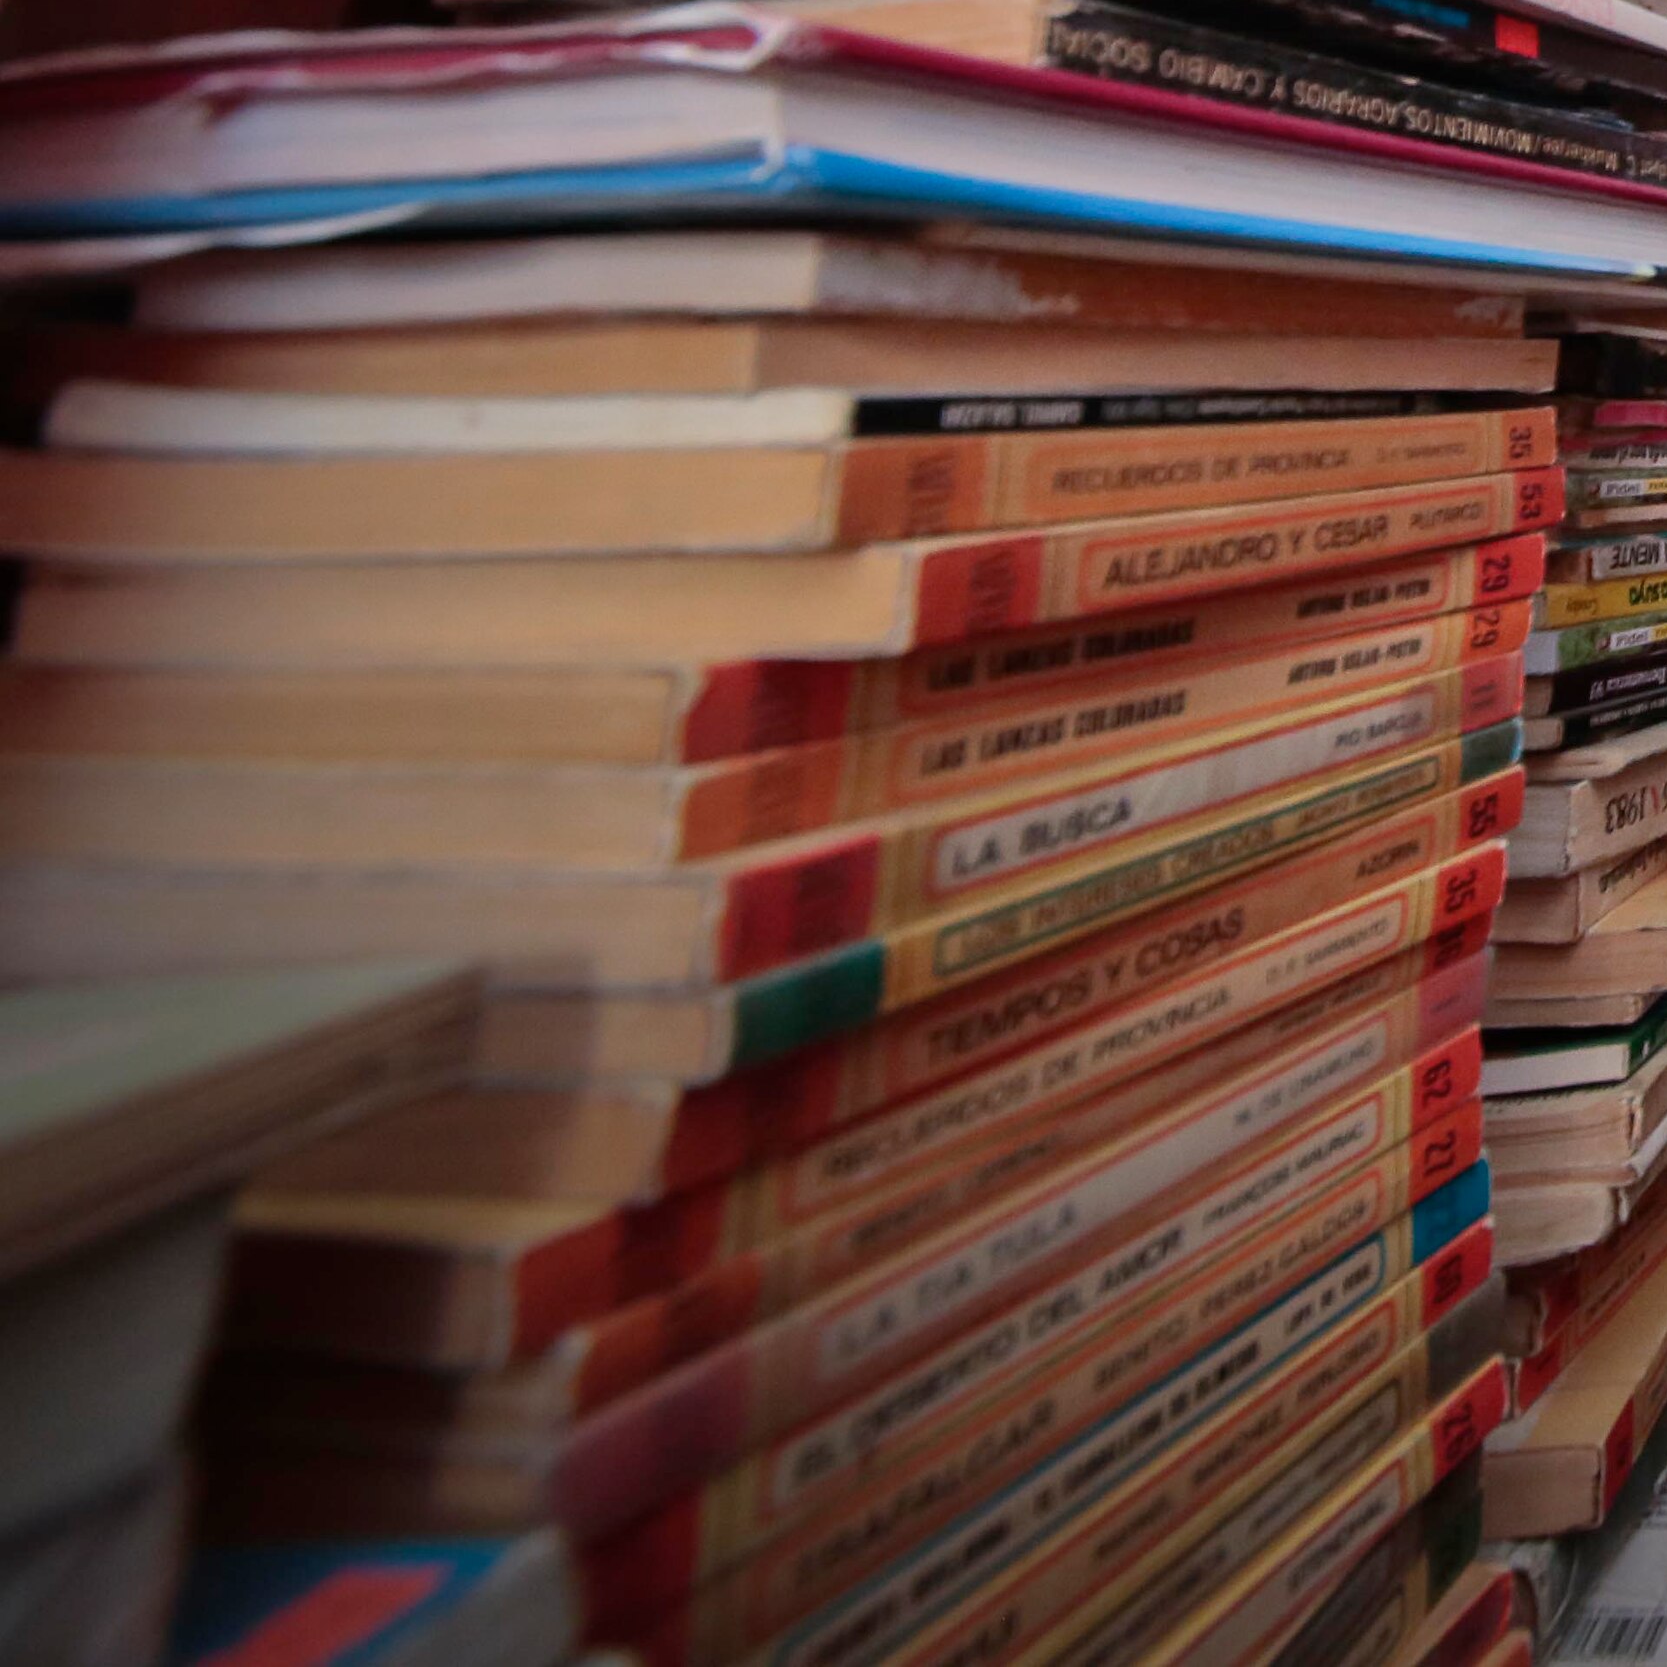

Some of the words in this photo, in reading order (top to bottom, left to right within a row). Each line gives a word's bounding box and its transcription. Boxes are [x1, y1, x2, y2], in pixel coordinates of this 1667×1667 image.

[1155, 46, 1265, 95] CAMBIO
[1289, 75, 1402, 123] AGRARIOS
[1400, 100, 1536, 151] MOVIMIENTOS
[1508, 424, 1534, 461] 35
[1053, 463, 1202, 493] RECUERDOS
[1208, 458, 1241, 481] DE
[1246, 449, 1354, 477] PROVINCIA
[1518, 482, 1546, 521] 53
[1099, 532, 1283, 591] ALEJANDRO
[1284, 528, 1309, 557] Y
[1310, 515, 1392, 551] CESAR
[1480, 554, 1512, 594] 29
[1607, 543, 1662, 568] MENTE
[1468, 610, 1501, 649] 29
[1468, 793, 1500, 834] 55
[1604, 786, 1650, 830] 1983
[947, 836, 1006, 875] LA
[1011, 795, 1136, 857] BUSCA
[1446, 868, 1477, 913] 35
[920, 968, 1101, 1067] TIEMPOS
[1127, 905, 1253, 978] COSAS
[1088, 1222, 1194, 1299] AMOR
